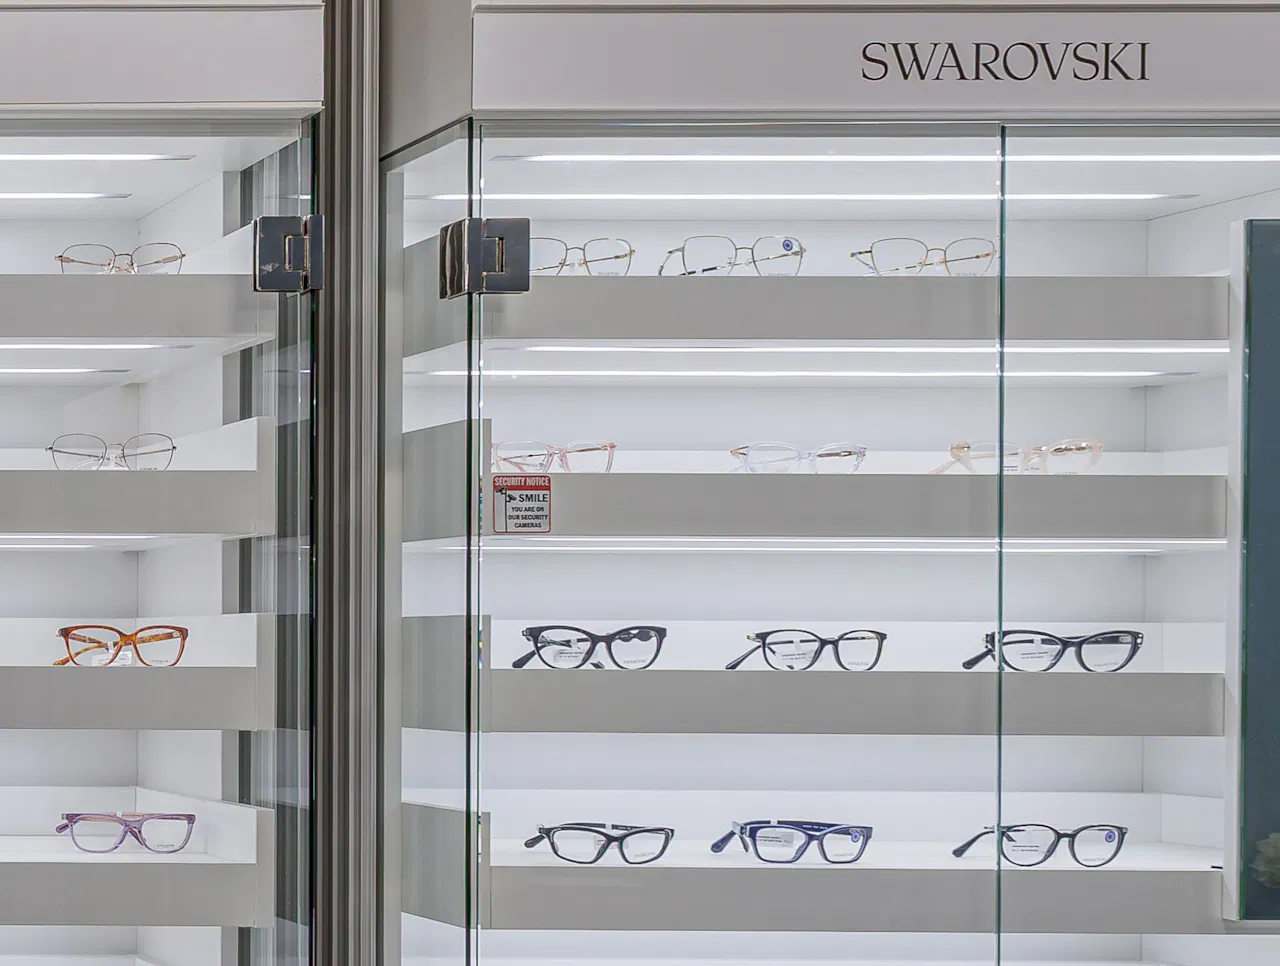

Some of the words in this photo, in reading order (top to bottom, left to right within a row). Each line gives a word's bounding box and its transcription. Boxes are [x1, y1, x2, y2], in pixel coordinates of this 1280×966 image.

[861, 41, 1151, 81] SWAROVSKI
[494, 477, 525, 486] SECURITY
[526, 477, 549, 486] NOTICE
[518, 493, 548, 503] SMILE
